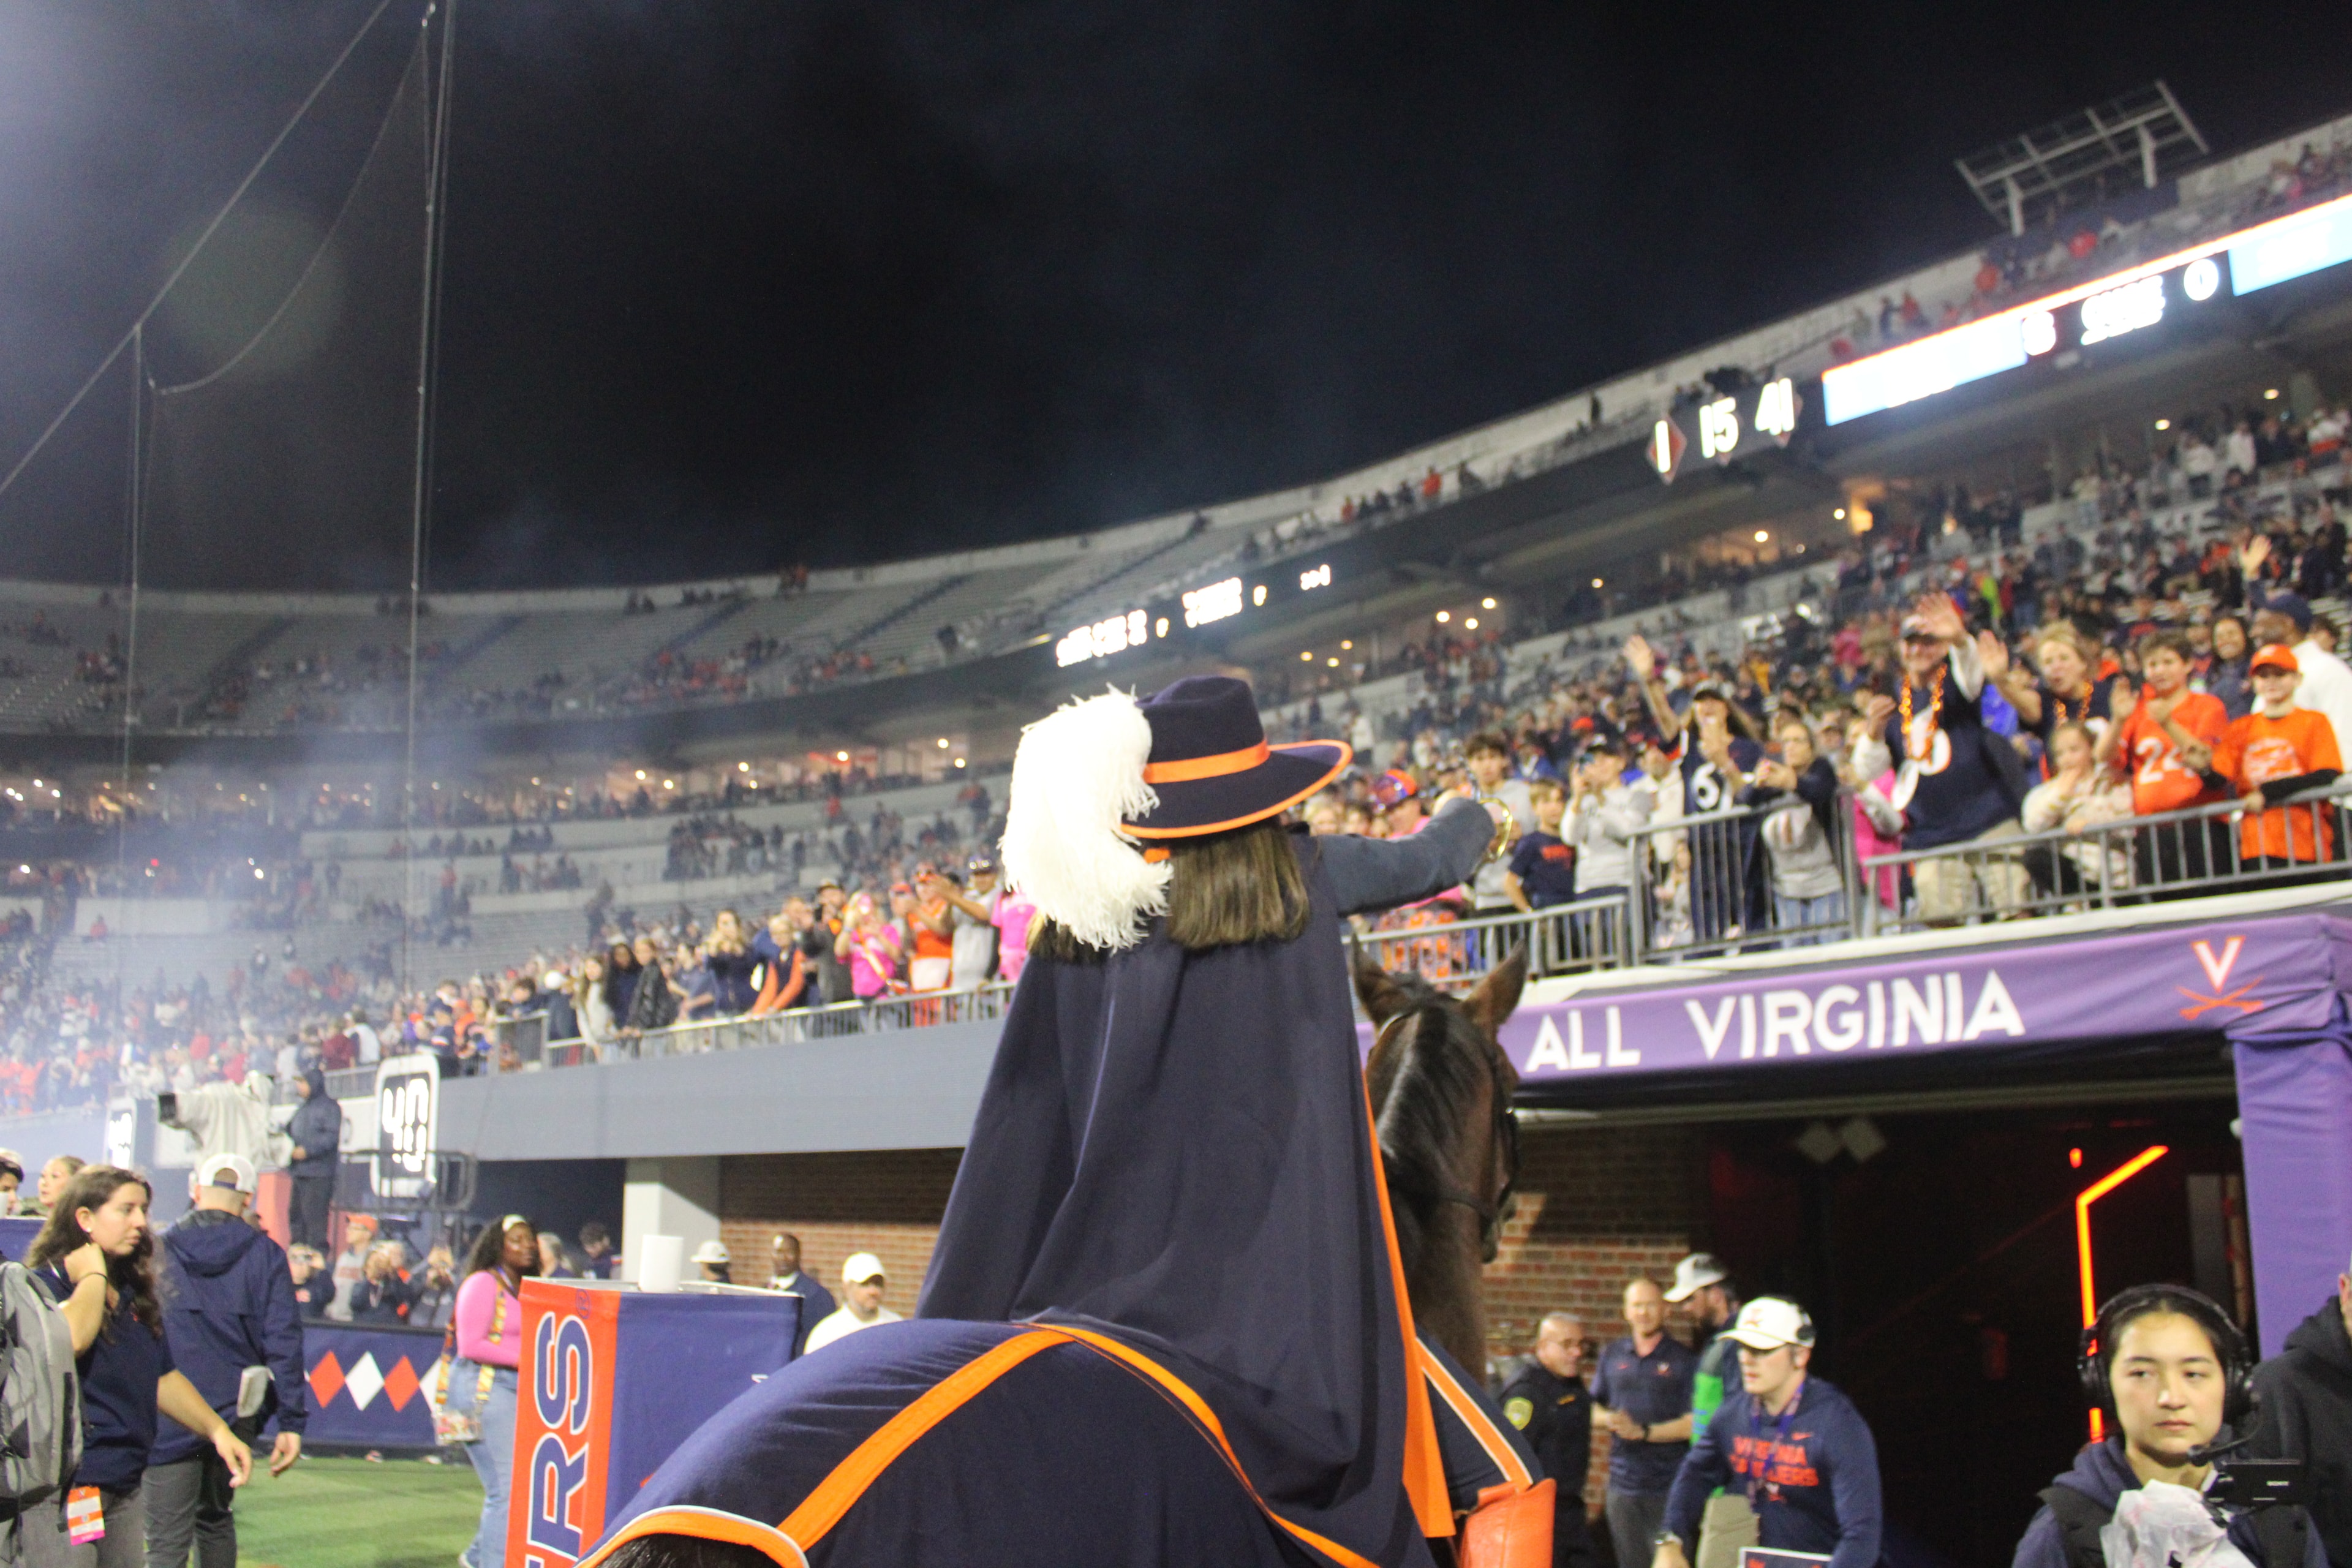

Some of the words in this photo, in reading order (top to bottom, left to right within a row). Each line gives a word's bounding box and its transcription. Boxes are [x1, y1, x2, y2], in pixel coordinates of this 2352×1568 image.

[1699, 397, 1739, 458] 15
[1755, 377, 1795, 435] 41
[1525, 1005, 1642, 1073] ALL
[1685, 969, 2026, 1060] VIRGINIA
[526, 1310, 593, 1568] RS
